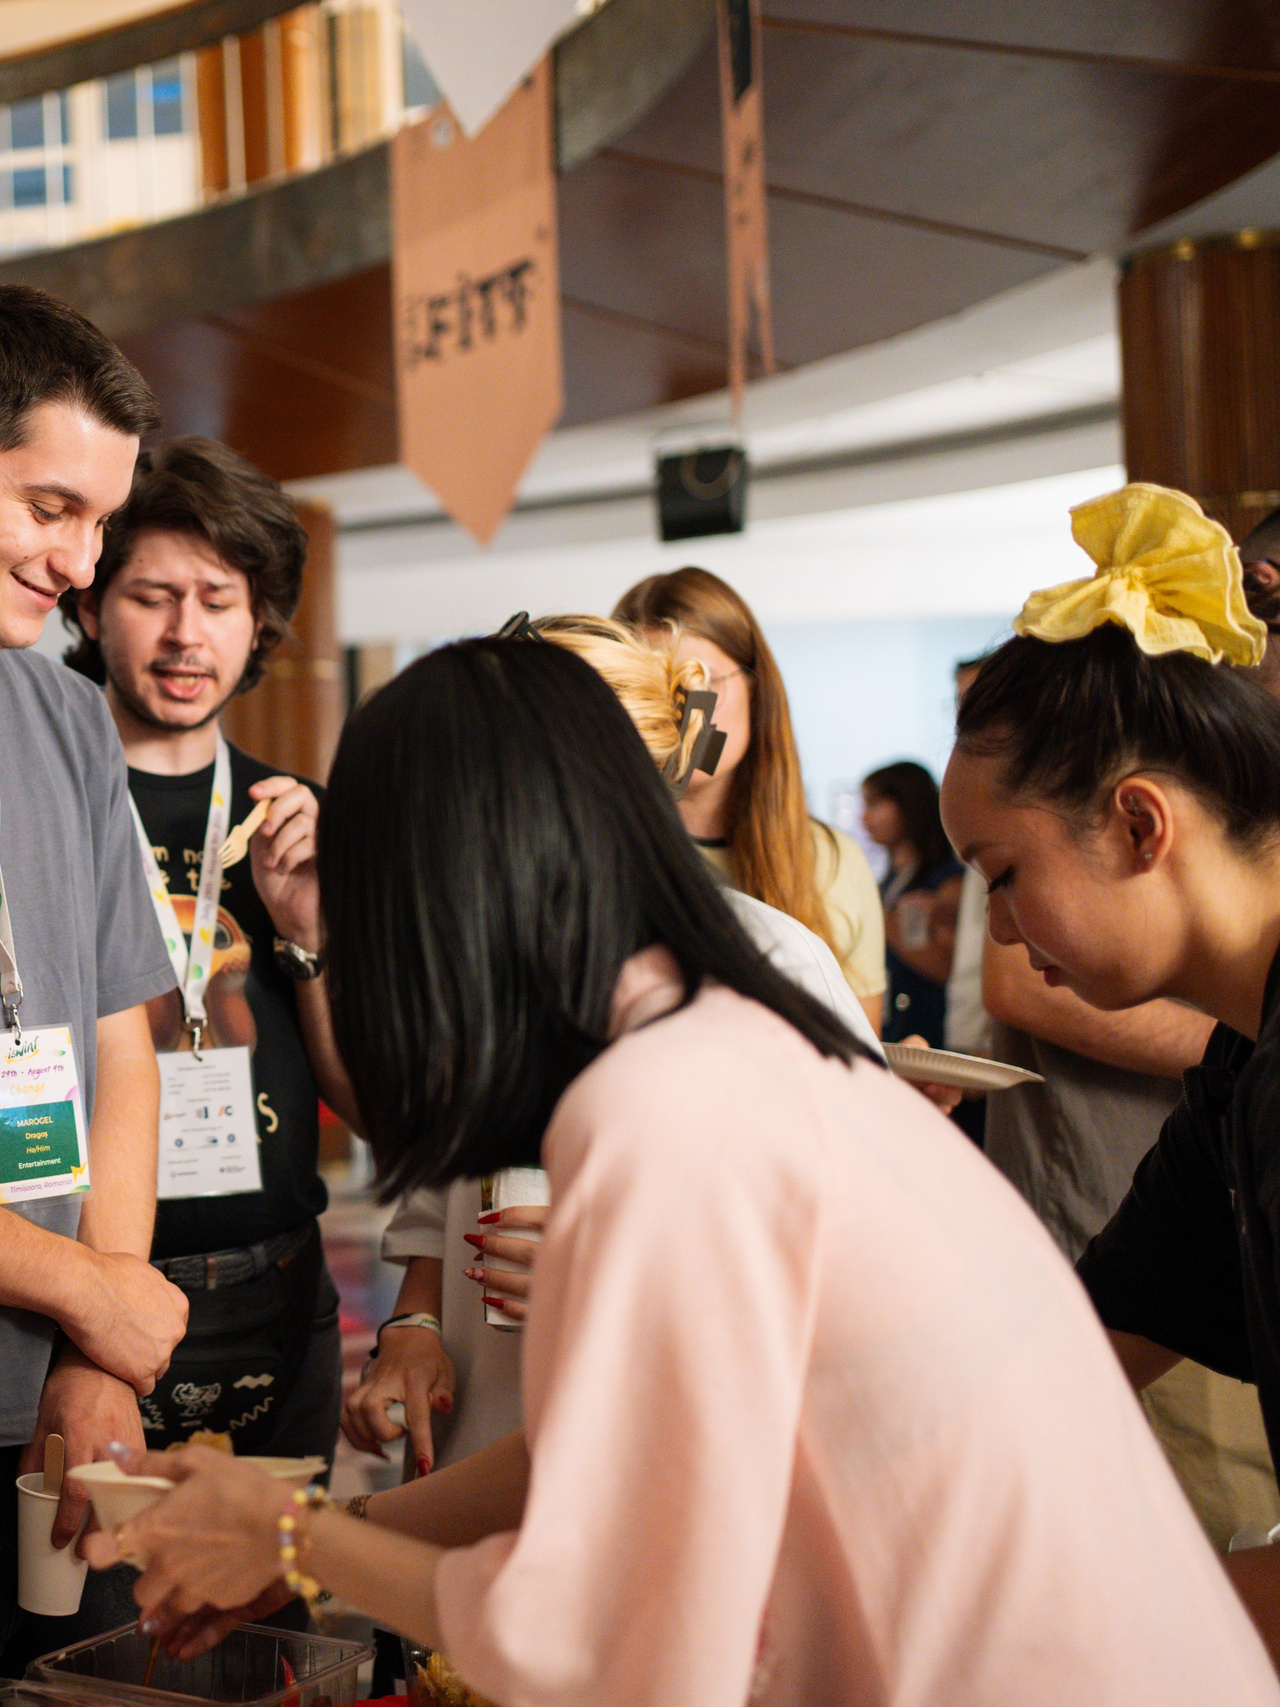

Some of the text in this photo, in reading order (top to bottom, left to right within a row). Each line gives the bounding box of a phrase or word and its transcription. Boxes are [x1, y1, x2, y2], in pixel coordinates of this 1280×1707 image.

[27, 1065, 51, 1080] August
[16, 1115, 54, 1128] MAROGEL
[26, 1144, 51, 1154] He/Him
[18, 1157, 62, 1169] Entertainment
[44, 1179, 72, 1188] Romania
